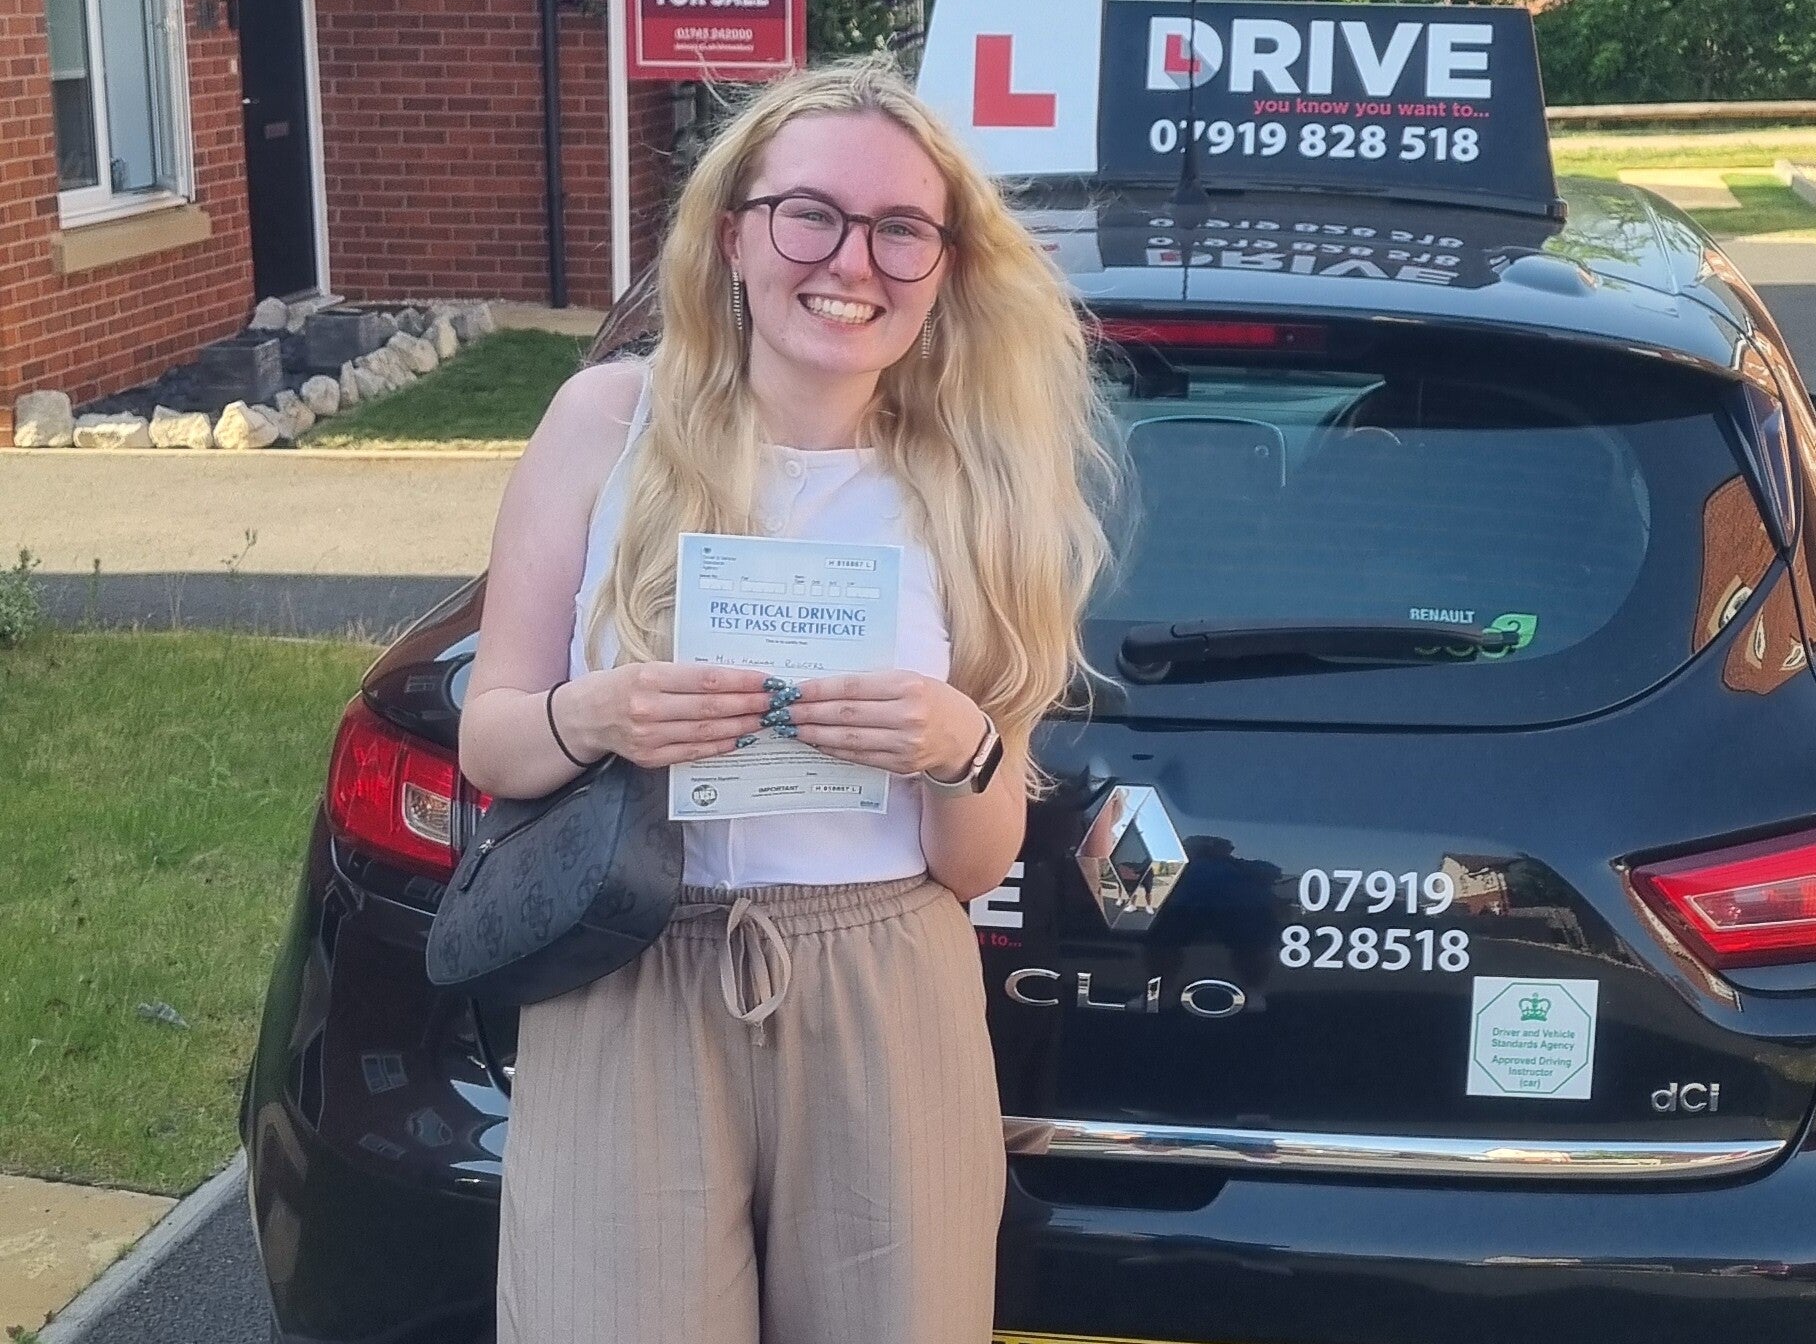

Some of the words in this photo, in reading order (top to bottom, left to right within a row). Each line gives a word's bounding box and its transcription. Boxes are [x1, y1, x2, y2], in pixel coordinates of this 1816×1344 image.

[1146, 16, 1494, 100] DRIVE
[972, 34, 1057, 128] L
[1254, 99, 1290, 117] you
[1296, 97, 1349, 114] know
[1355, 101, 1391, 118] you
[1398, 101, 1447, 117] want
[1452, 102, 1490, 118] to...
[1298, 122, 1387, 159] 828
[1399, 126, 1480, 162] 518
[710, 601, 793, 619] PRACTICAL
[797, 606, 866, 622] DRIVING
[1409, 608, 1475, 624] RENAULT
[710, 616, 740, 630] TEST
[745, 619, 777, 632] PASS
[780, 621, 866, 637] CERTIFICATE
[758, 785, 799, 793] IMPORTANT
[1300, 868, 1454, 915] 07919
[1279, 925, 1470, 972] 828518
[1004, 968, 1245, 1018] CLIO
[1492, 1027, 1520, 1037] Driver
[1522, 1029, 1540, 1038] and
[1542, 1029, 1575, 1039] Vehicle
[1491, 1038, 1538, 1049] Standards
[1540, 1040, 1574, 1051] Agency
[1491, 1055, 1536, 1066] Approved
[1538, 1056, 1572, 1069] Driving
[1508, 1067, 1554, 1077] Instructor
[1519, 1078, 1541, 1090] (car)
[1651, 1082, 1721, 1113] dCi
